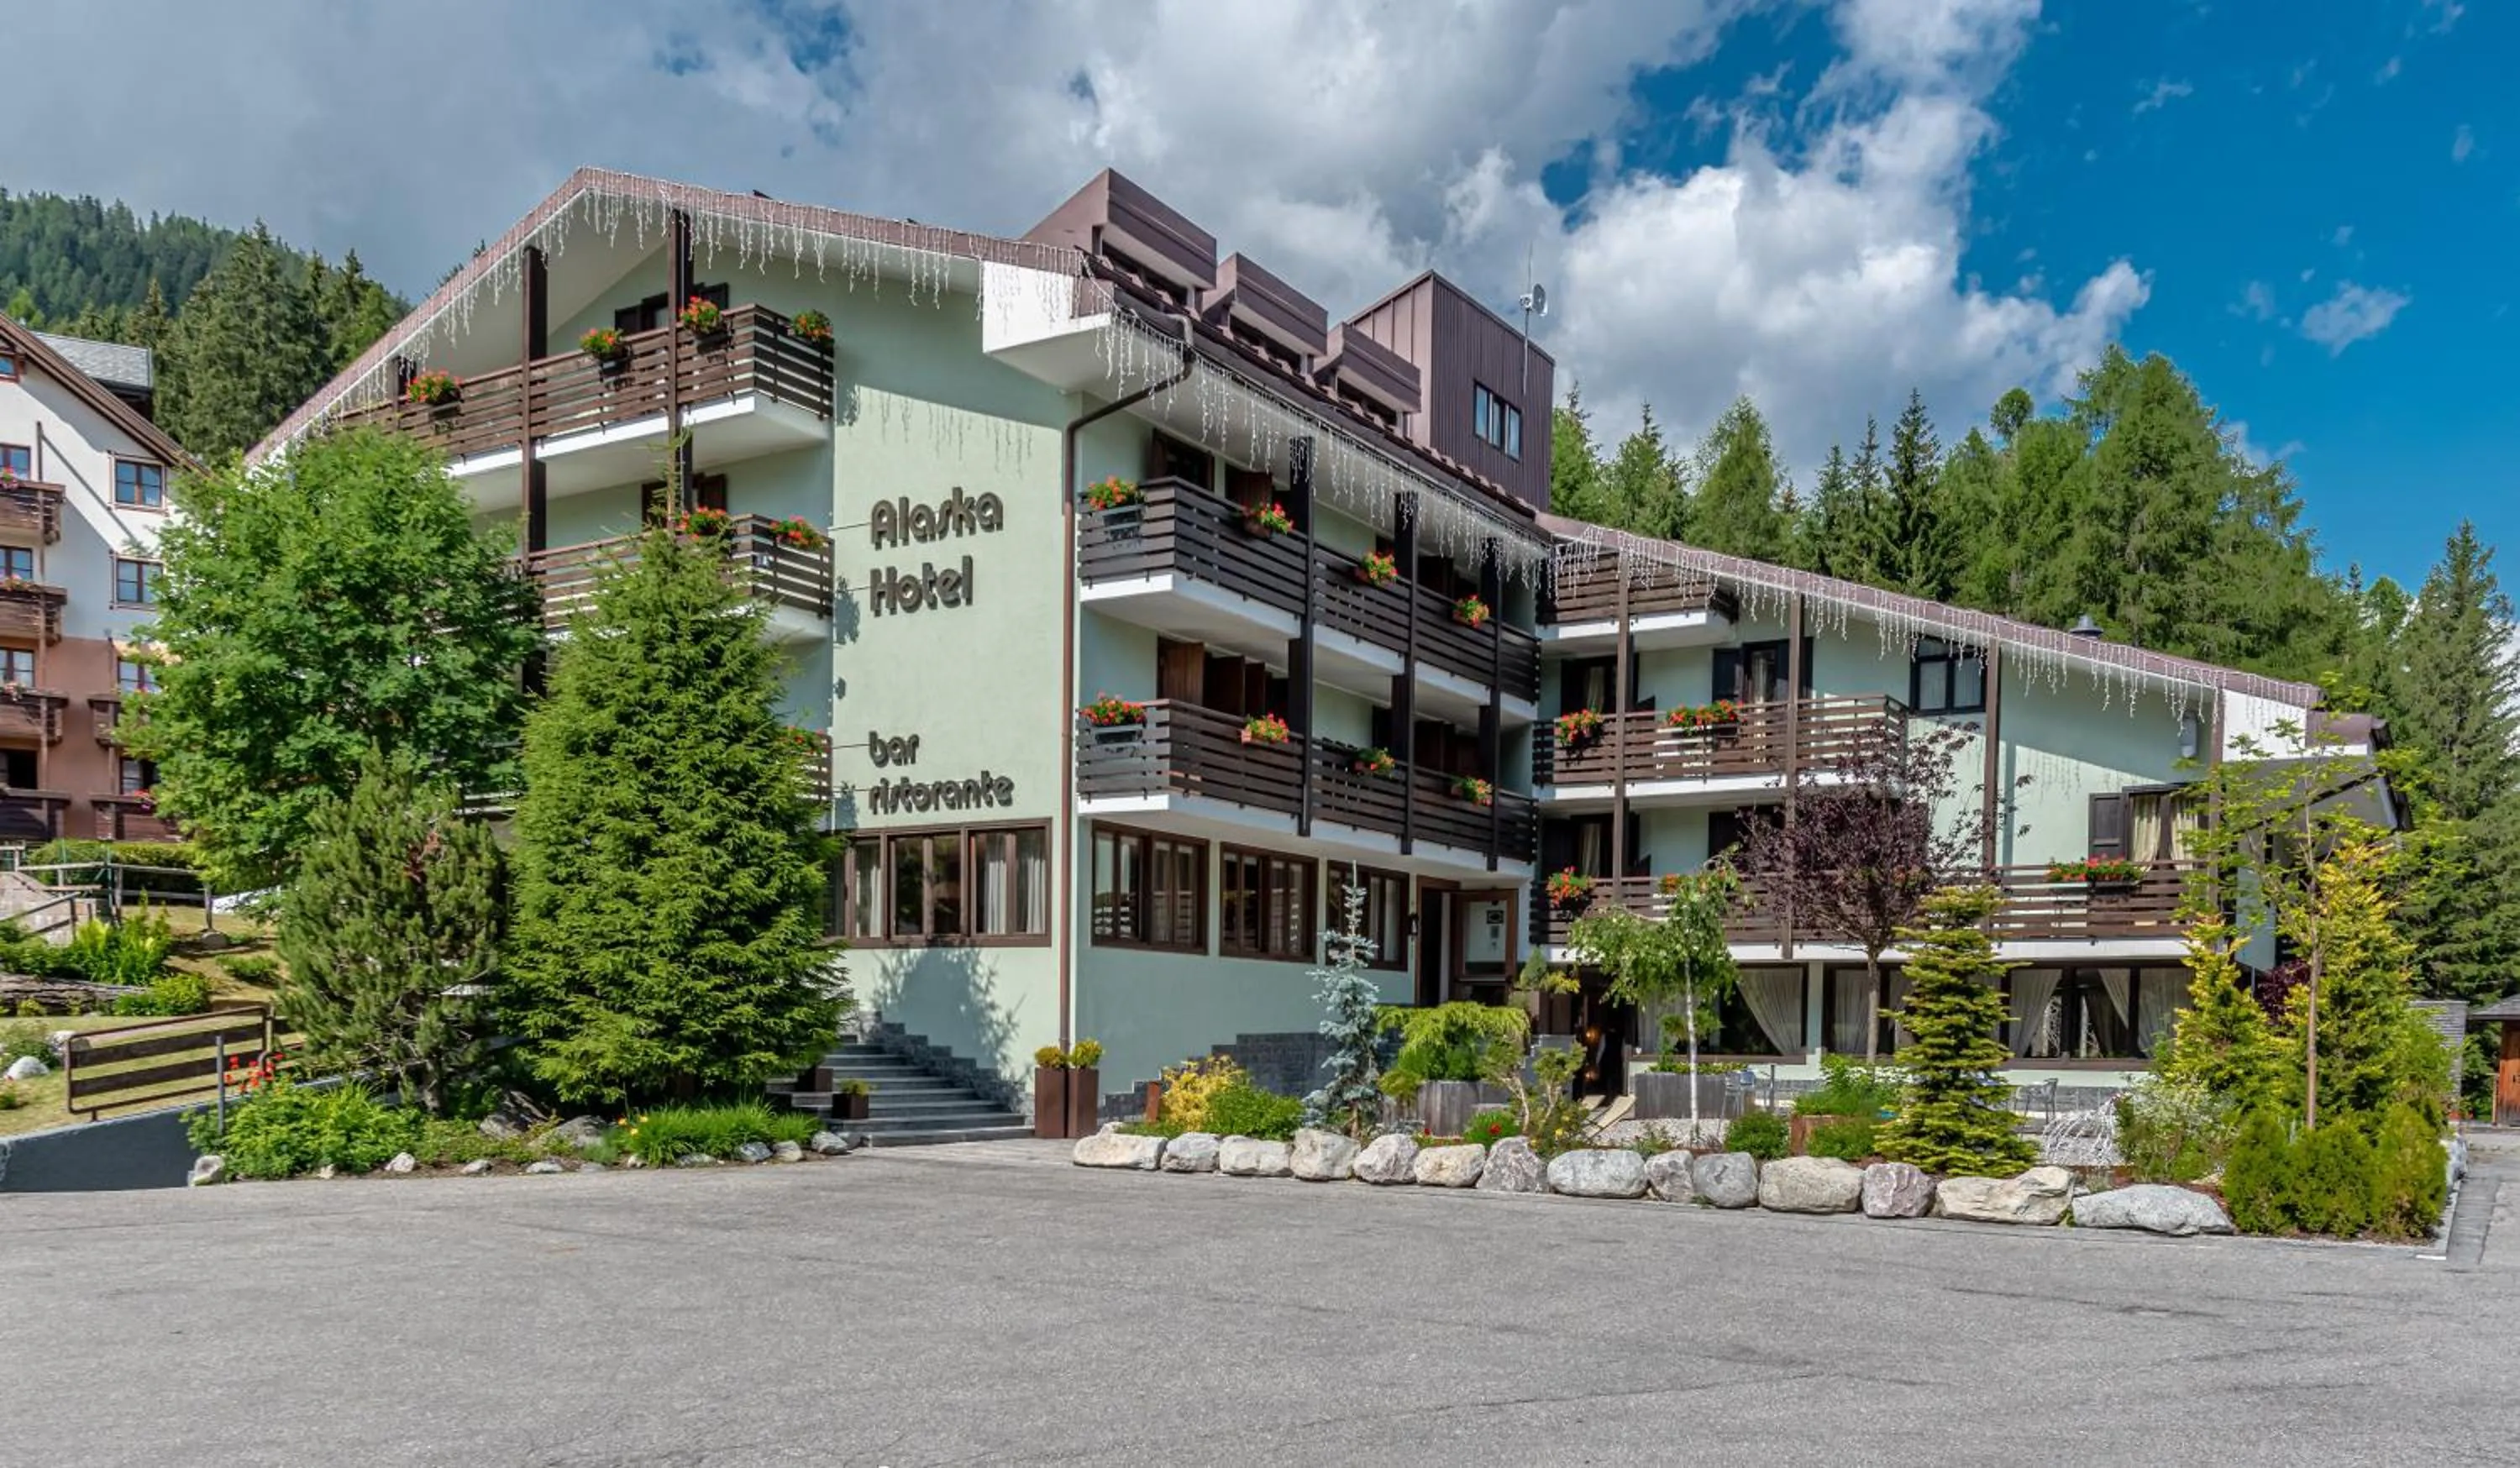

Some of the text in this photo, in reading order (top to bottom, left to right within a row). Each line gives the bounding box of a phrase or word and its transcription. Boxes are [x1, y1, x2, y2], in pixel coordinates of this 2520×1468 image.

[871, 487, 1004, 550] Alaska
[870, 556, 973, 616] Hotel
[869, 731, 919, 768] bar
[869, 770, 1014, 815] ristorante
